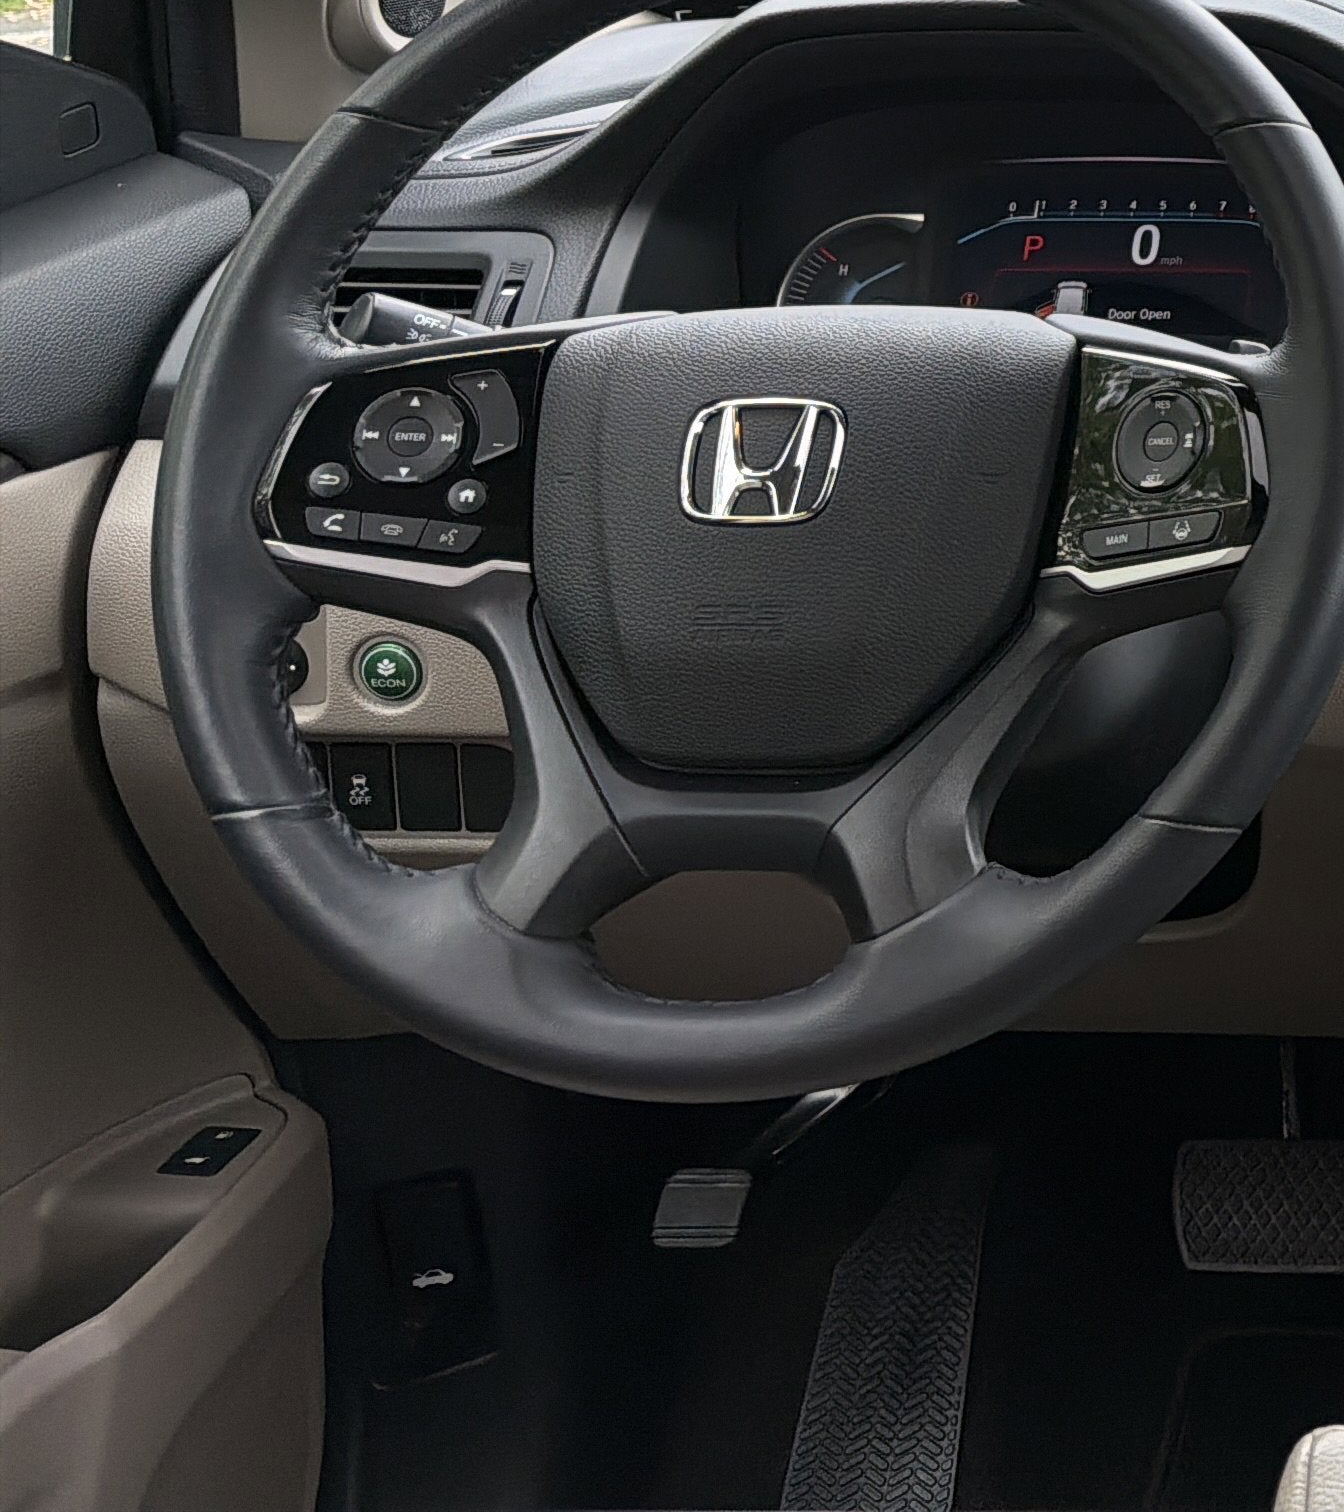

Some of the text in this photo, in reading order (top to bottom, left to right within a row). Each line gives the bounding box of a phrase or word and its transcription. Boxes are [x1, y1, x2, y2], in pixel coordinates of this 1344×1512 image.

[1009, 202, 1017, 212] 0
[1069, 200, 1078, 210] 2
[1099, 200, 1108, 210] 3
[1130, 200, 1138, 210] 4
[1160, 200, 1168, 210] 5
[1190, 200, 1198, 211] 6
[1219, 200, 1228, 211] 7
[1023, 235, 1045, 262] P
[1130, 224, 1161, 267] 0
[1160, 255, 1183, 267] mph
[838, 263, 849, 277] H
[1108, 308, 1171, 322] Door Open
[1155, 400, 1171, 409] RES
[394, 432, 427, 442] ENTER
[1147, 437, 1175, 446] CANCEL
[1145, 473, 1161, 482] SET
[1105, 534, 1129, 546] MAIN
[370, 678, 406, 688] ECON
[349, 796, 372, 806] OFF
